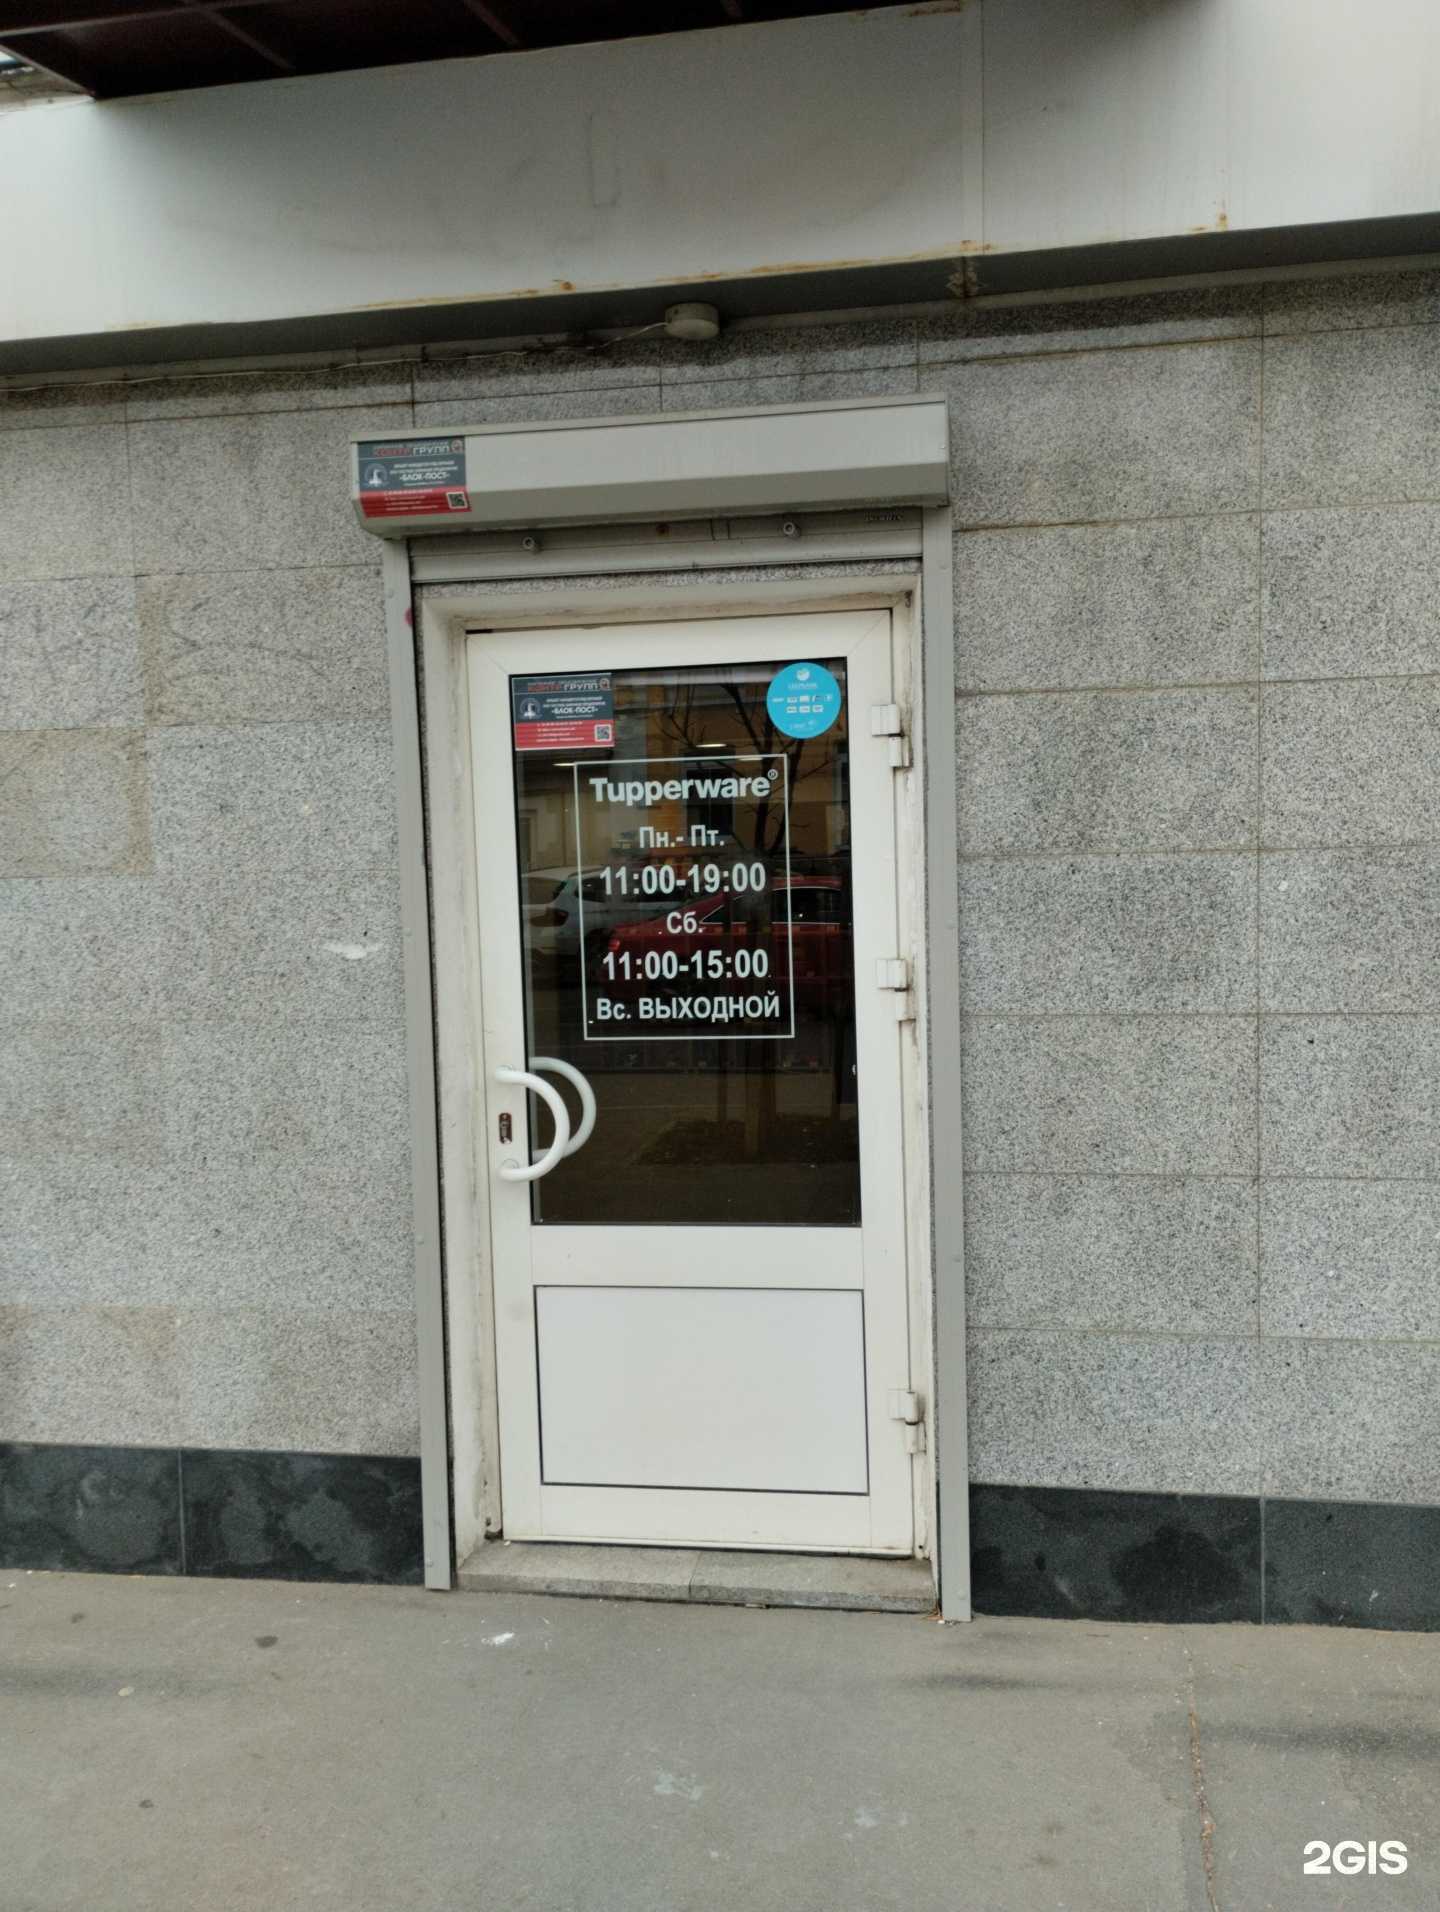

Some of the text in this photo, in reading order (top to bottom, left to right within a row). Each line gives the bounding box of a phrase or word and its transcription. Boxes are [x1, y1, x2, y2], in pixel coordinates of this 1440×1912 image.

[690, 824, 725, 847] Пт.
[600, 862, 767, 895] 11:00-19:00
[666, 911, 704, 934] Сб.
[602, 948, 769, 981] 11:00-15:00
[596, 990, 780, 1023] Вс. ВЫХОДНОЙ
